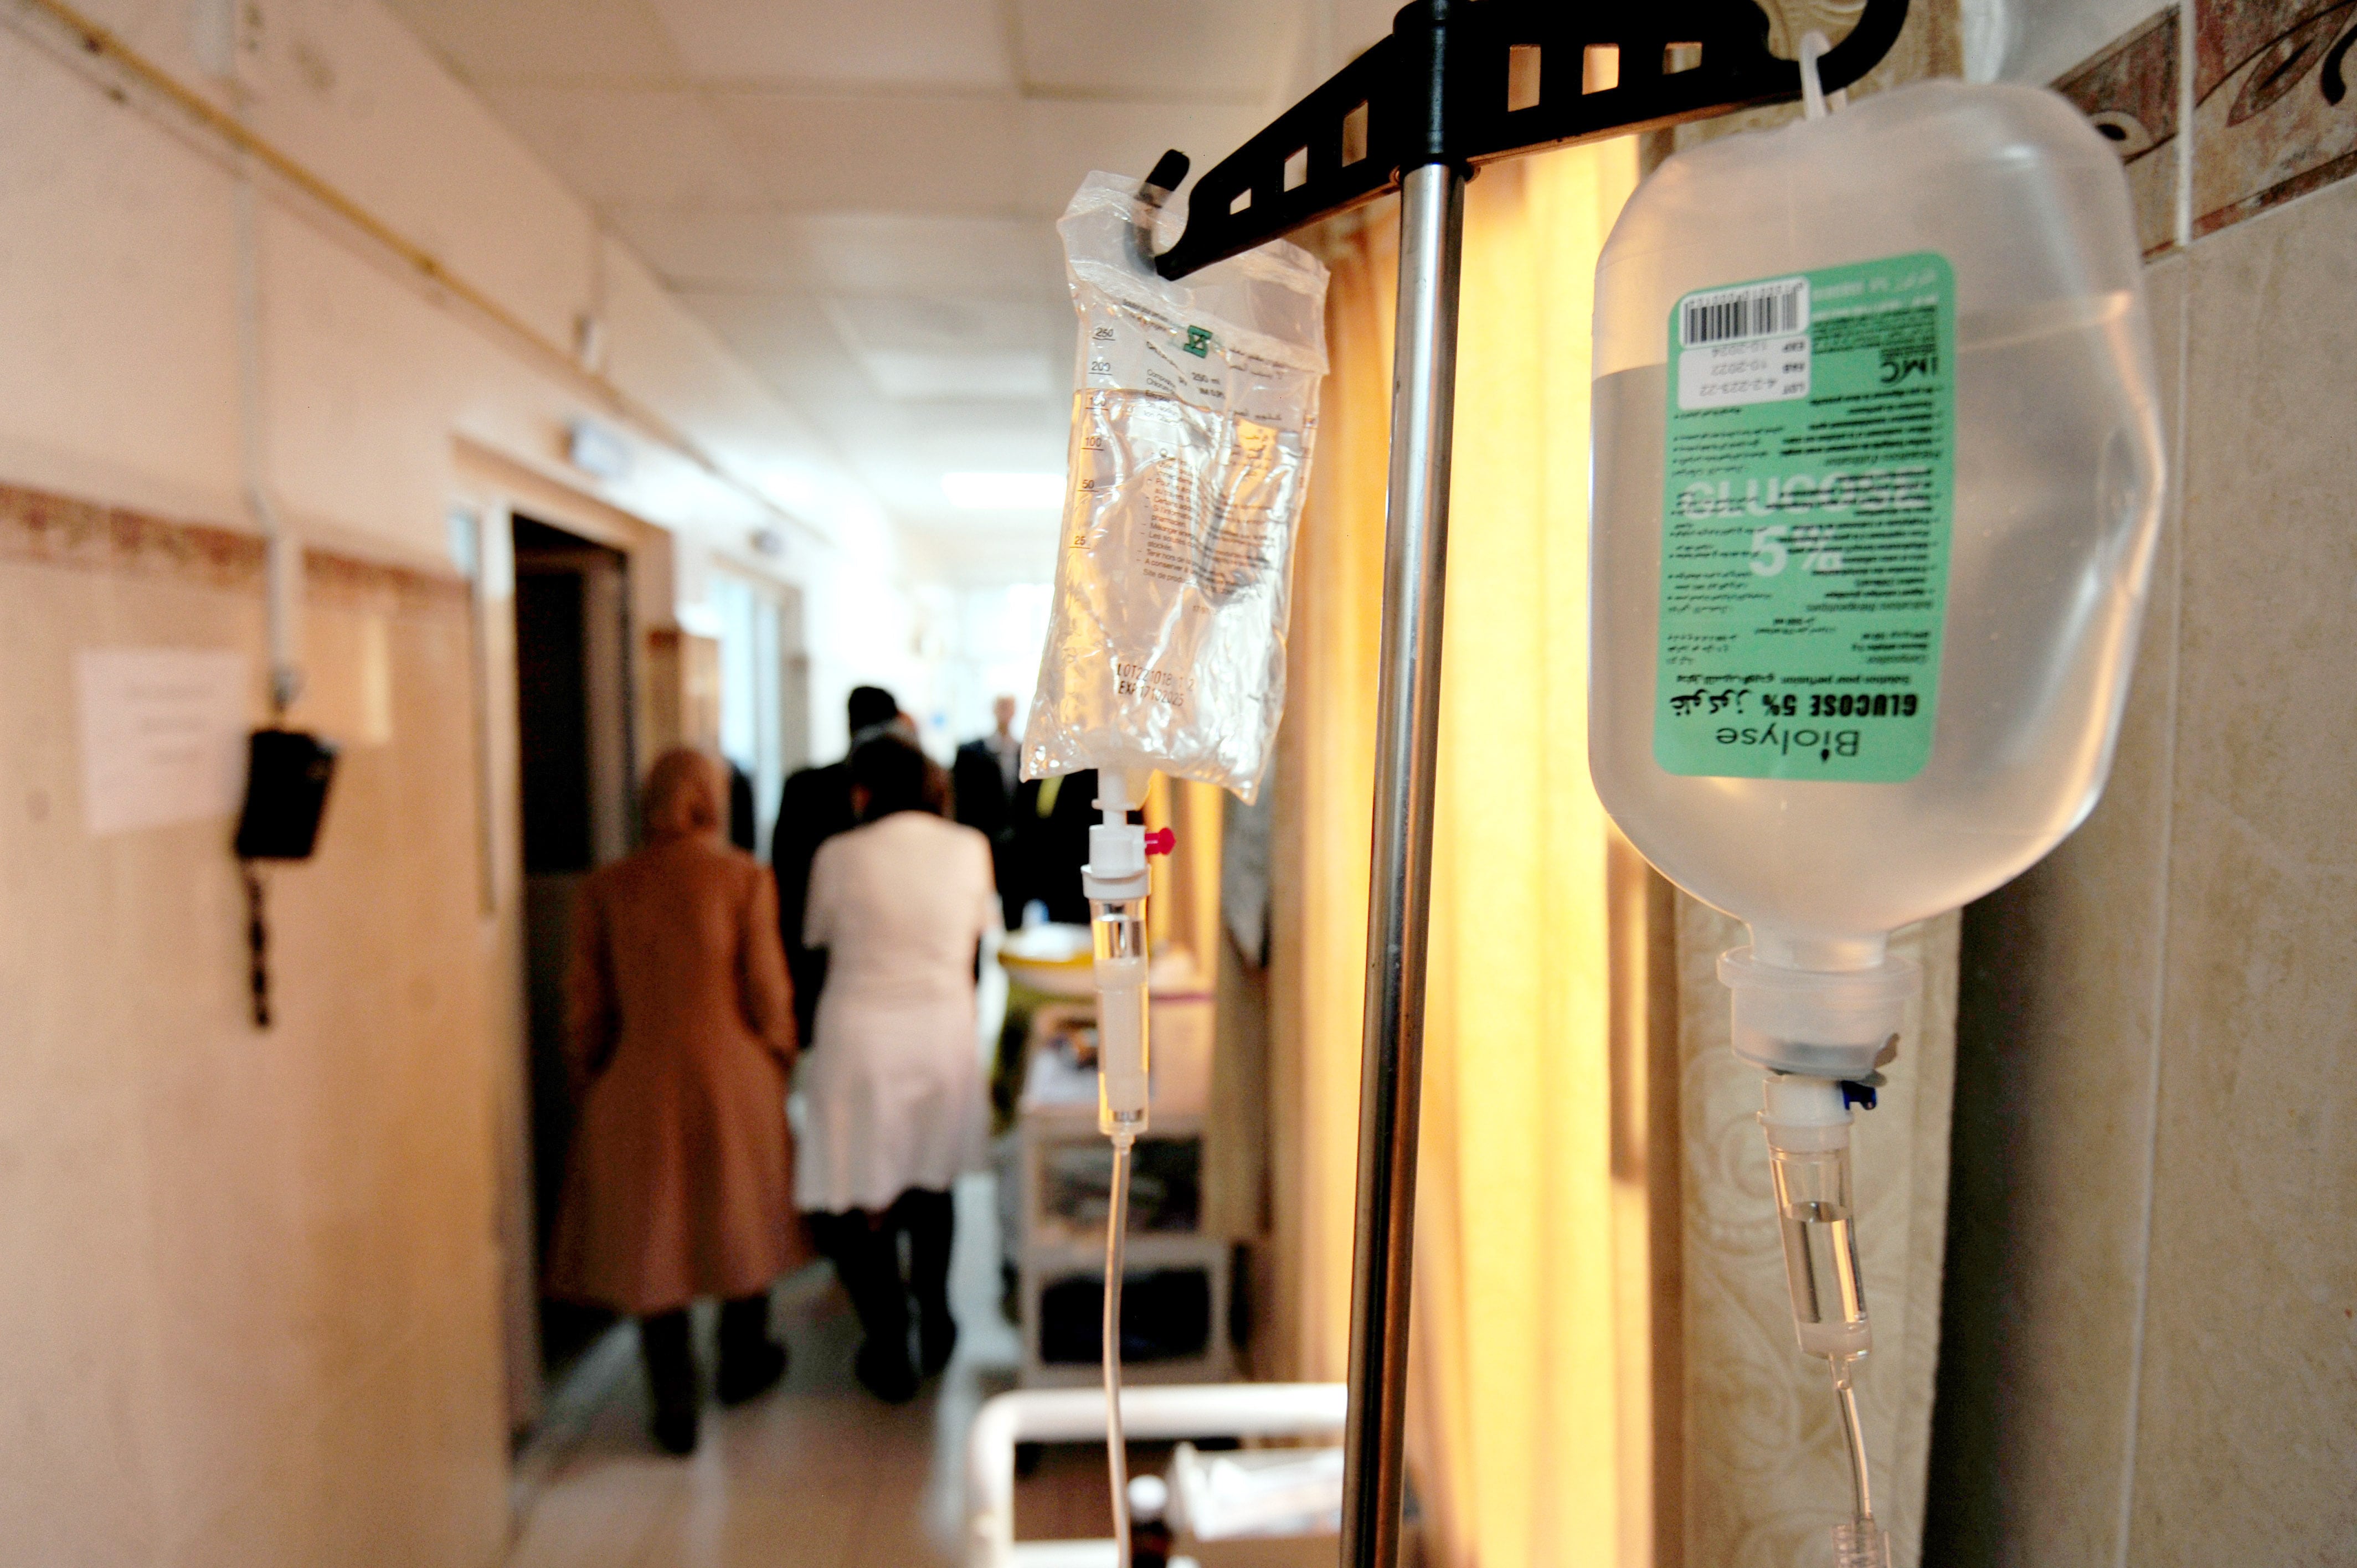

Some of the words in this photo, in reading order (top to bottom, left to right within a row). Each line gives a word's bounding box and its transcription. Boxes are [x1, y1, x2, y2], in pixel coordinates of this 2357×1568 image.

[1096, 328, 1114, 337] 250
[1092, 362, 1110, 372] 200
[1085, 437, 1102, 447] 100
[1082, 479, 1094, 488] 50
[1680, 467, 1931, 519] GLUCOSE
[1074, 536, 1086, 545] 25
[1669, 688, 1750, 716] غلوكوز
[1761, 693, 1796, 716] 5%
[1808, 693, 1917, 716] GLUCOSE
[1715, 722, 1860, 761] Biolyse
